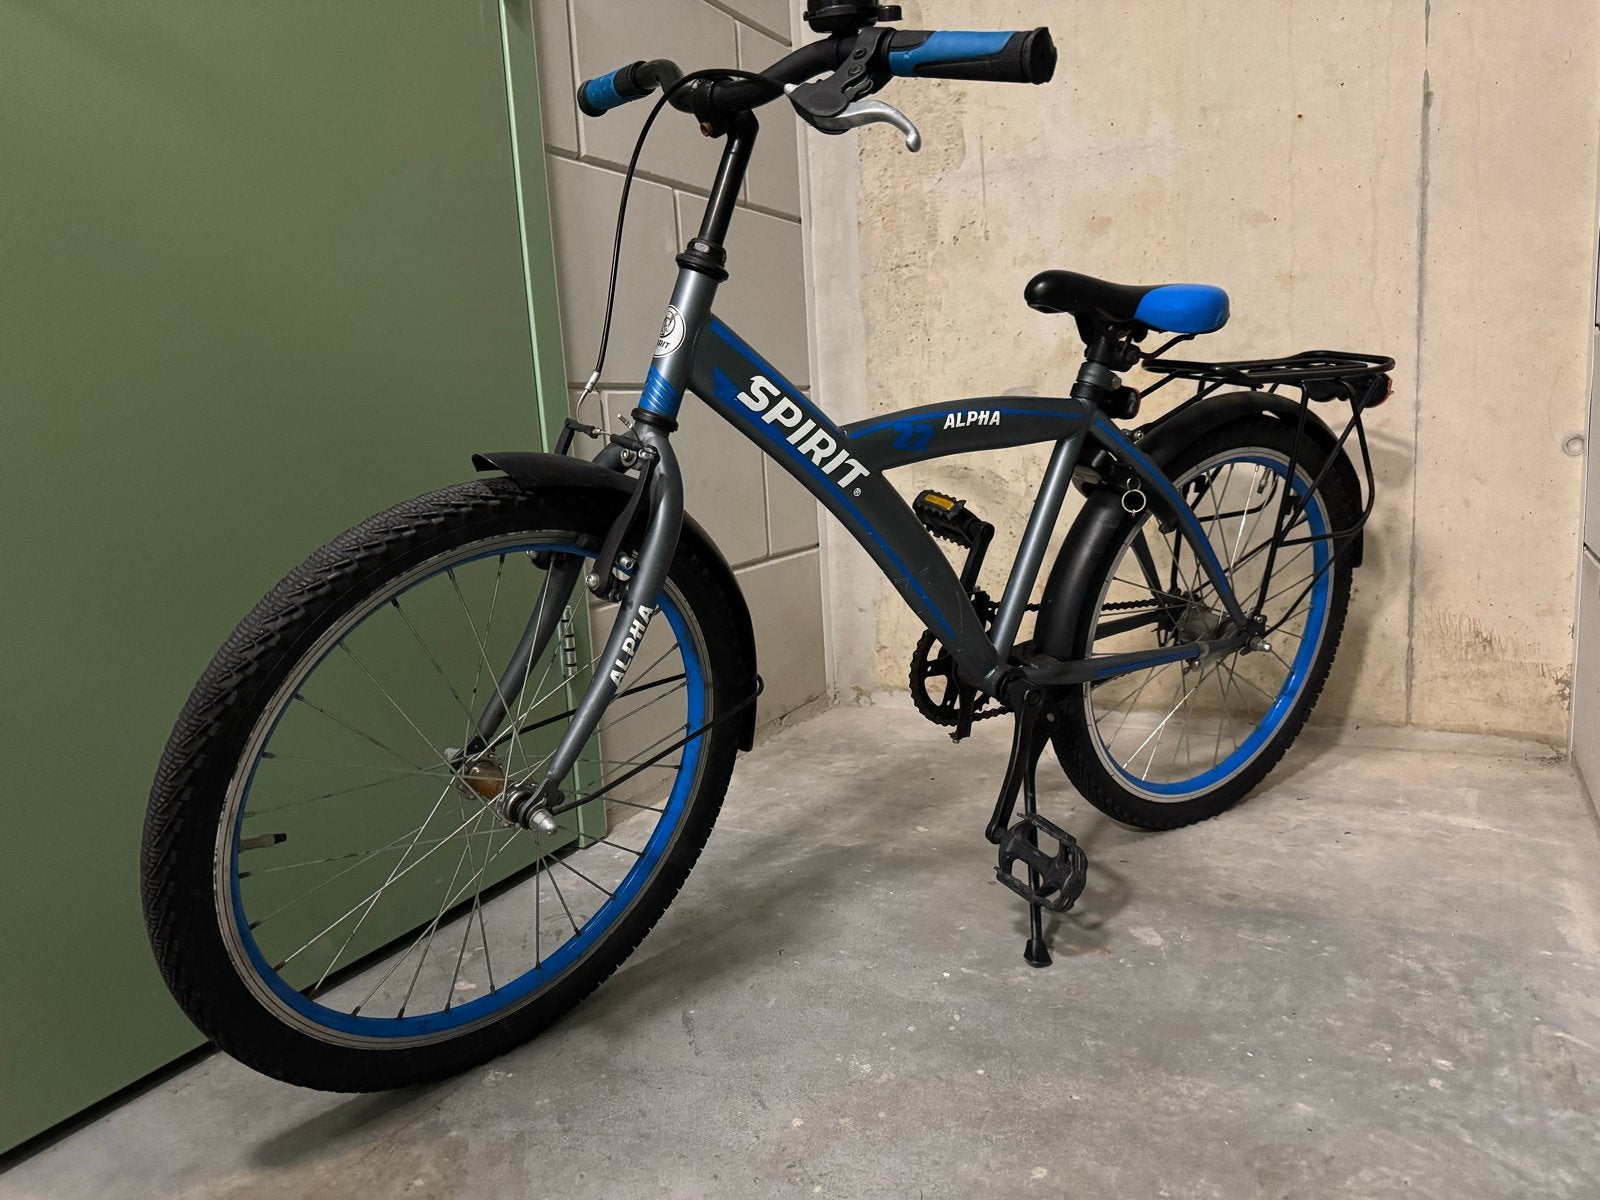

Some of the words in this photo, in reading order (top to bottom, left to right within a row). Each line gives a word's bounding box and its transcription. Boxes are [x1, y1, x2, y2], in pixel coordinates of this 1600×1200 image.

[736, 375, 871, 489] SPIRIT
[892, 421, 935, 451] 22
[943, 410, 1001, 430] ALPHA
[610, 604, 654, 688] ALPHA
